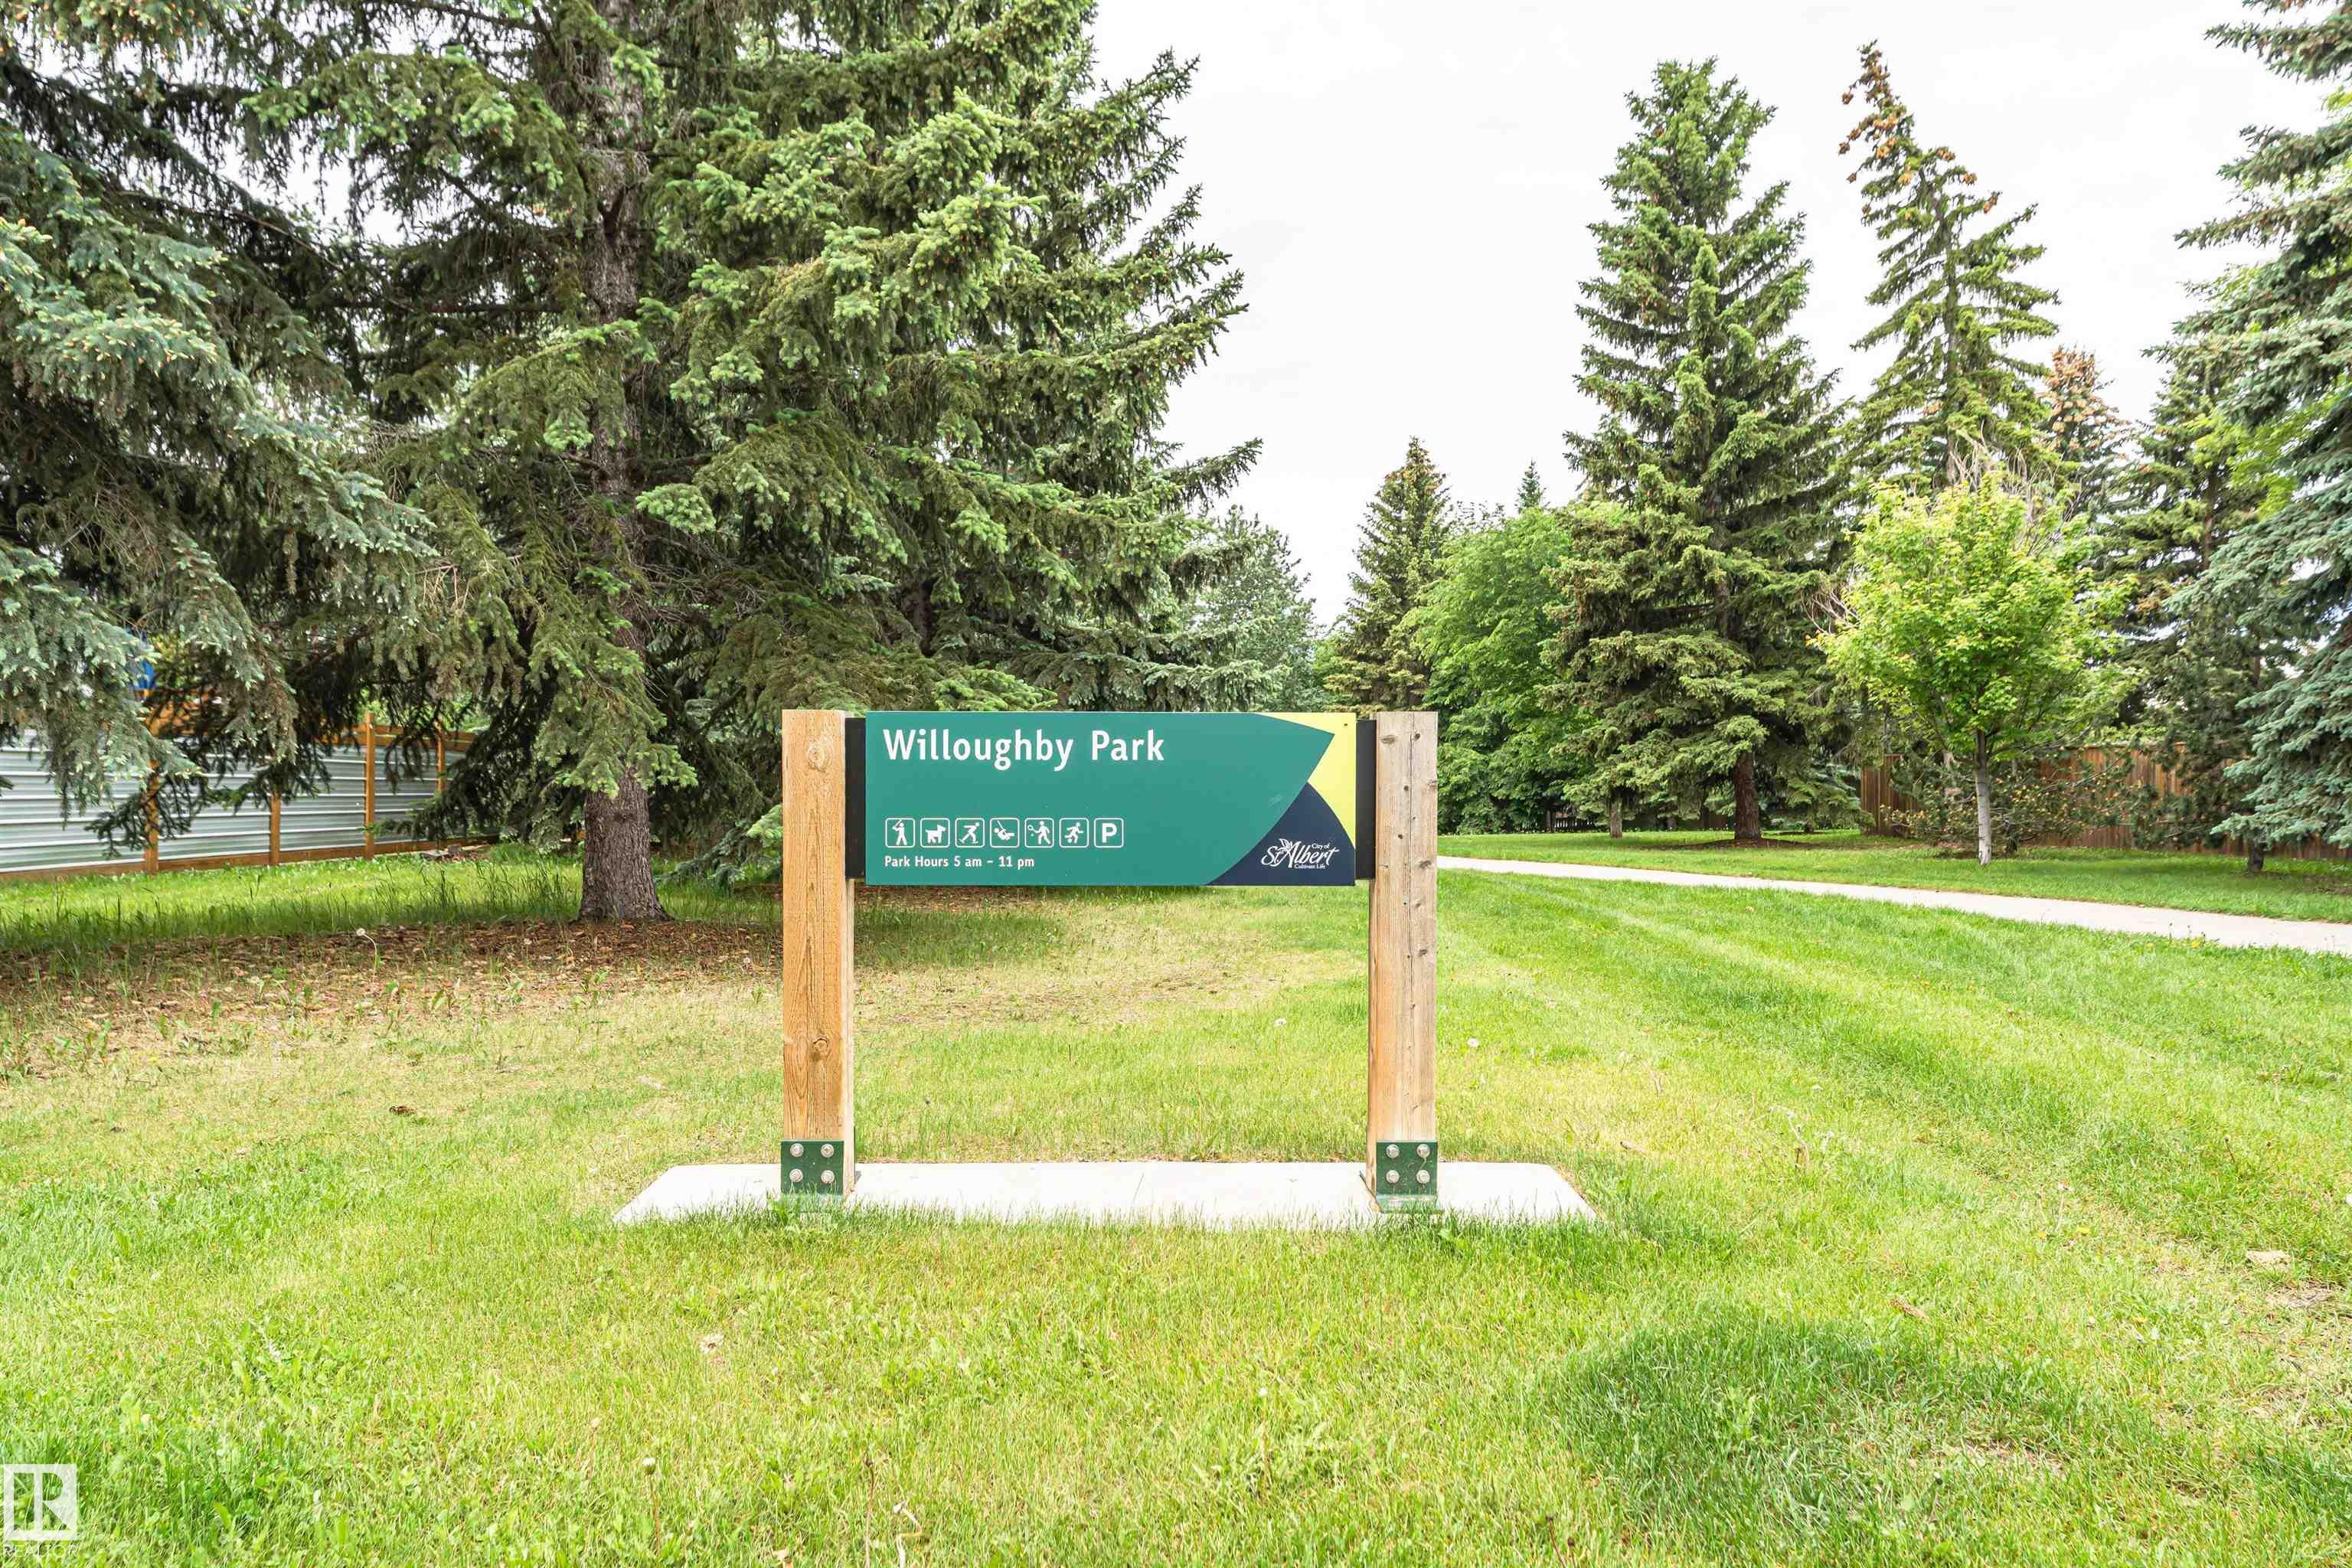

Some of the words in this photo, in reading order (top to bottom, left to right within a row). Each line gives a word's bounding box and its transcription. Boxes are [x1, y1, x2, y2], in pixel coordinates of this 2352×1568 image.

[883, 729, 1073, 771] Willoughby
[1091, 729, 1165, 761] Park
[1102, 823, 1117, 842] P
[884, 856, 910, 867] Park
[915, 856, 949, 867] Hours
[954, 856, 961, 867] 5
[965, 858, 982, 867] am
[998, 856, 1013, 867] 11
[1017, 858, 1035, 870] pm
[1279, 840, 1340, 868] Albert
